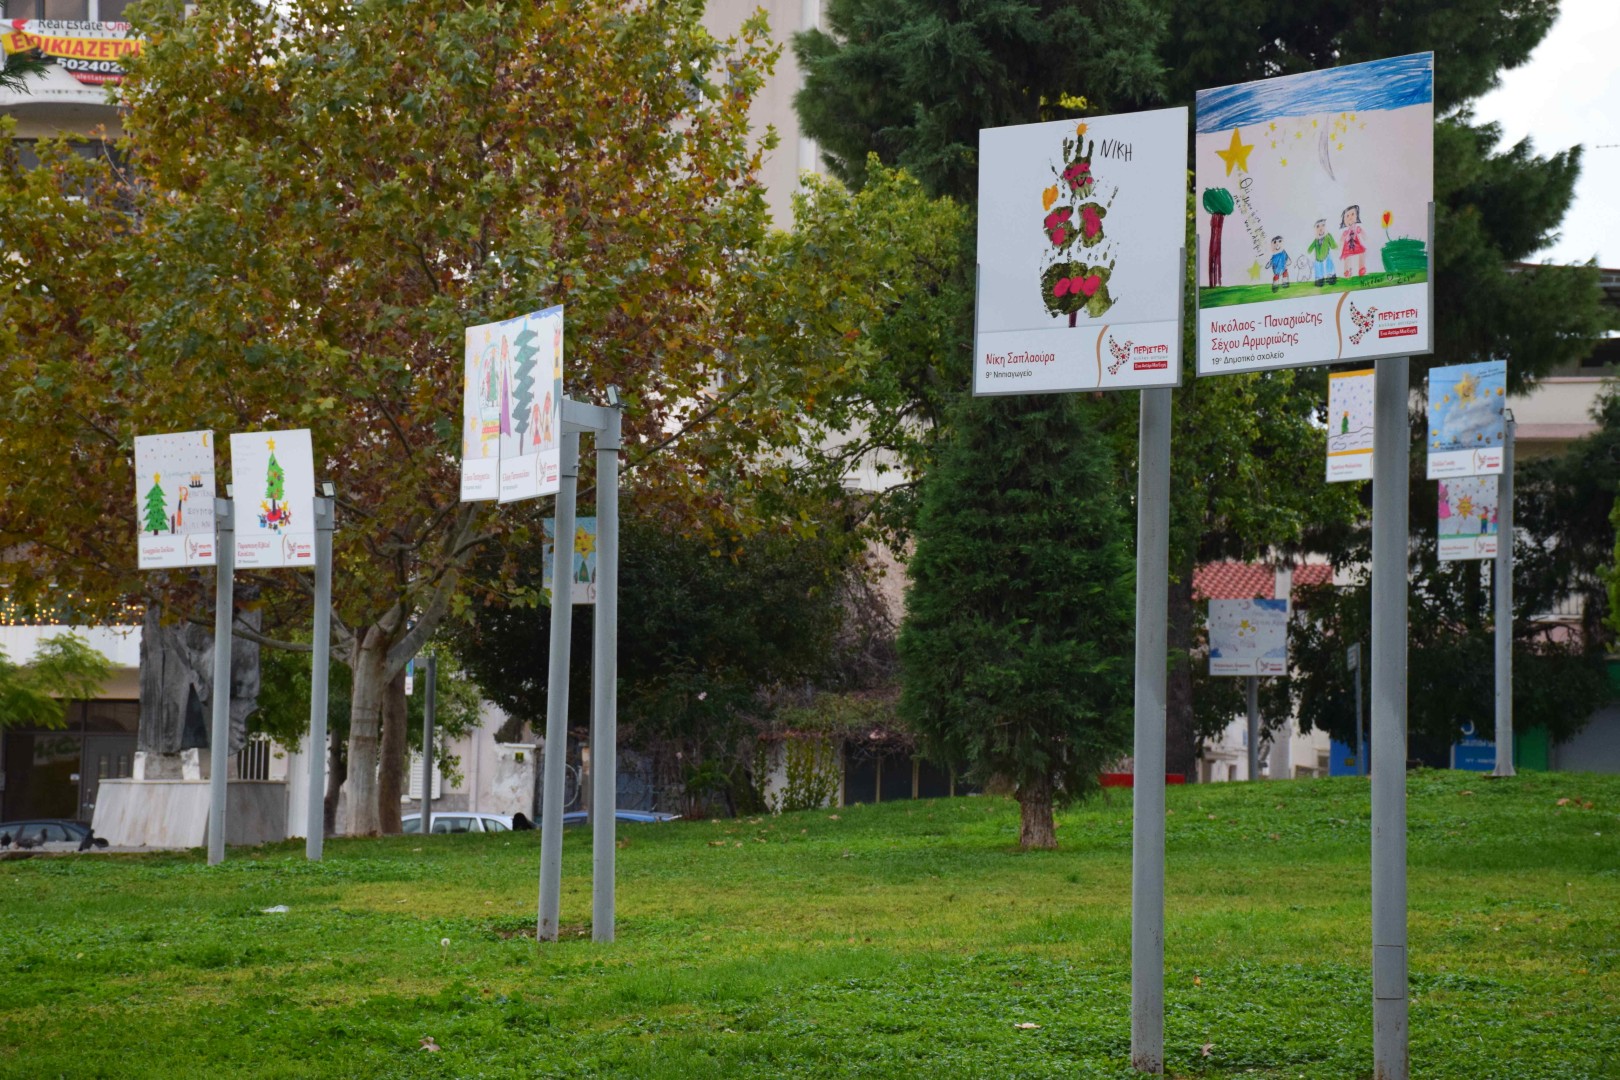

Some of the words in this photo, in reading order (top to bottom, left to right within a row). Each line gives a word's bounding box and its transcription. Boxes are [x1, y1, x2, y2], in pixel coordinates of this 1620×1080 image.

[38, 19, 62, 30] Real
[66, 20, 103, 31] Estate
[104, 21, 132, 32] One
[56, 57, 128, 73] 502402
[1100, 138, 1132, 162] ΝΙΚΗ
[1211, 318, 1256, 334] Νικόλαος
[1264, 312, 1323, 329] Παναγιώτης
[1211, 338, 1240, 353] Σέχου
[985, 353, 1005, 368] Νίκη
[1007, 350, 1055, 366] Σαπλαούρα
[1223, 353, 1255, 365] Δημοτικό
[1256, 350, 1285, 361] σχολείο
[993, 369, 1033, 379] Νηπιαγωγείο
